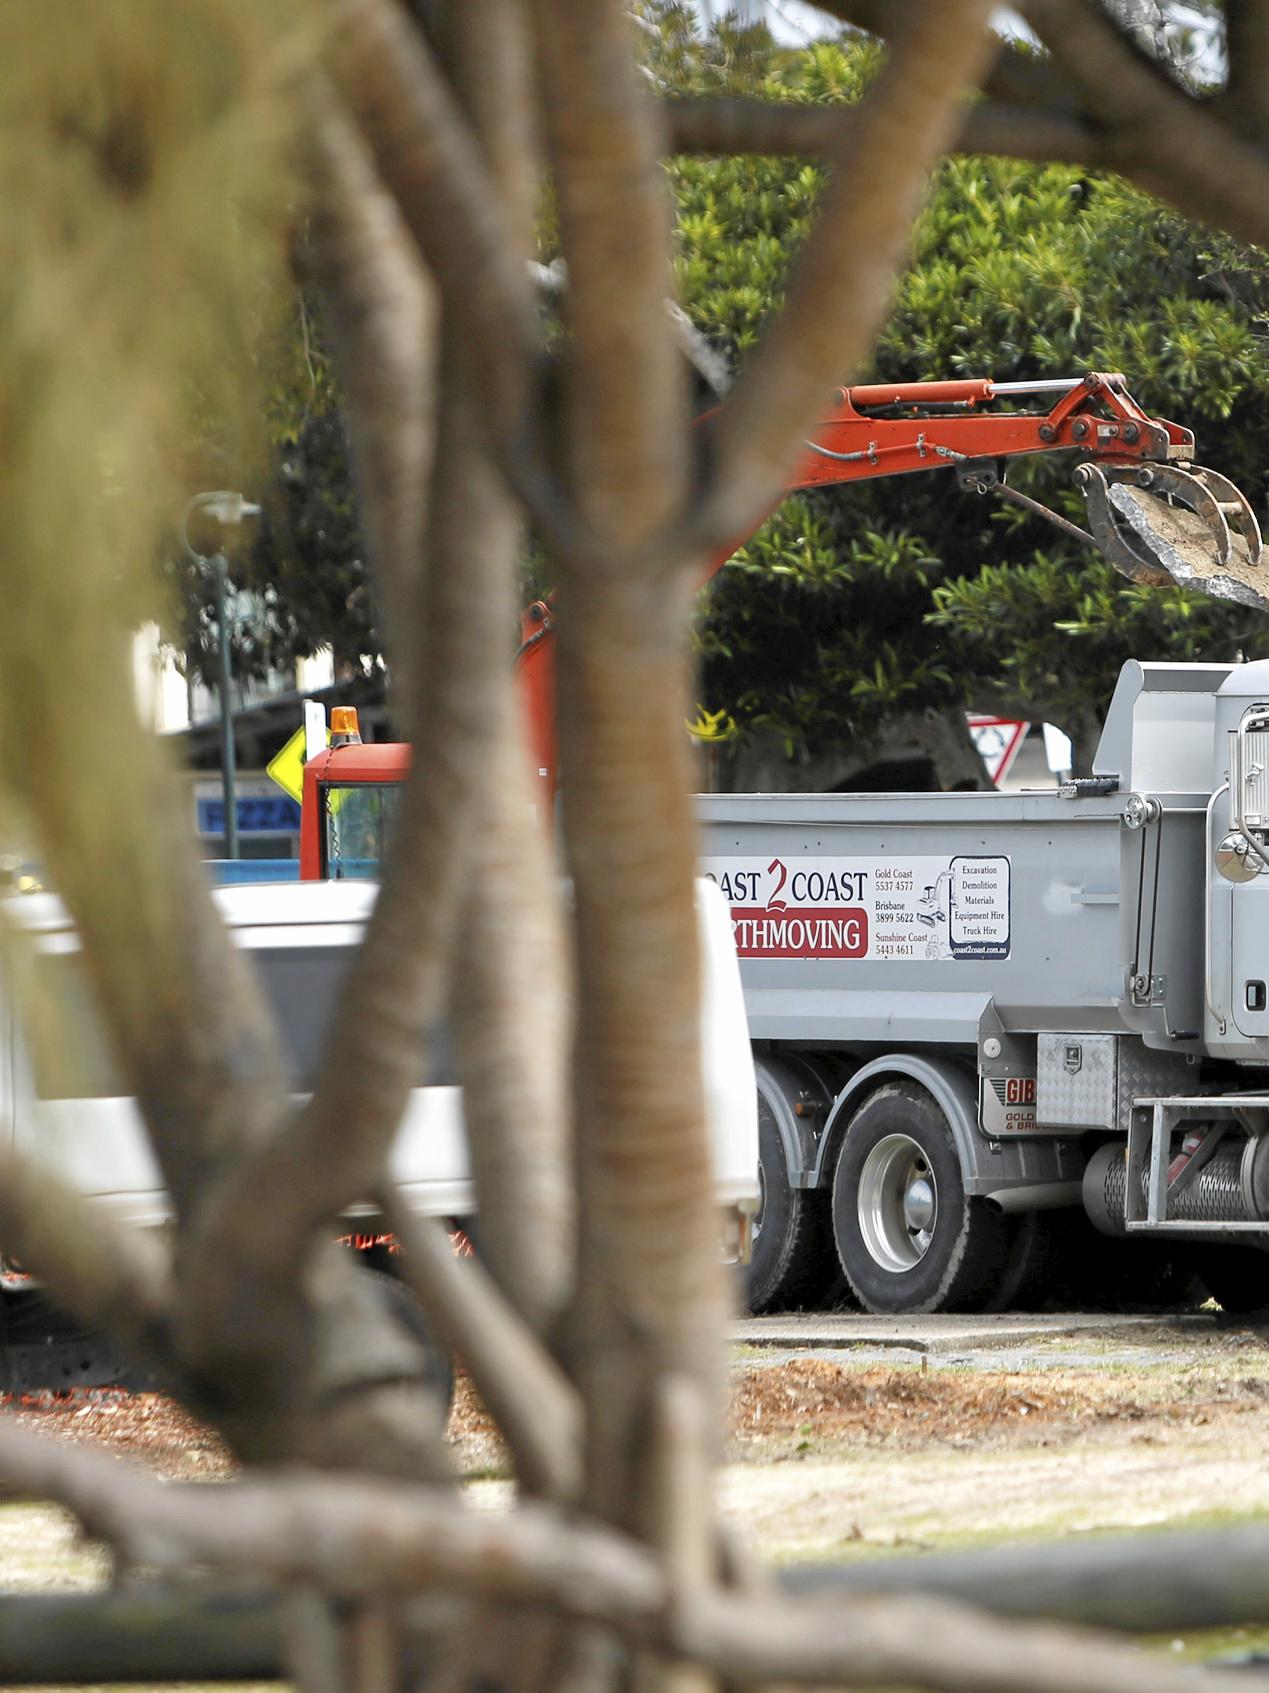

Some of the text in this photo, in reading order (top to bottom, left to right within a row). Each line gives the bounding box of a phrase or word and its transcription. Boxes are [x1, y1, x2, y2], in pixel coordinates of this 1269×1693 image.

[205, 800, 300, 830] PZZA
[875, 869, 913, 879] Gold Coast
[962, 866, 997, 874] Excavation
[767, 858, 787, 911] 2
[791, 872, 868, 901] COAST
[875, 882, 913, 891] 5537 4577
[962, 881, 997, 889] Demolition
[965, 896, 995, 904] Materials
[876, 901, 905, 910] Brisbane
[876, 913, 914, 923] 3899 5622
[955, 911, 1005, 921] Equipment Hire
[731, 919, 860, 949] RTHMOVING
[963, 926, 997, 935] Truck Hire
[876, 932, 928, 942] Sunshine Coast
[876, 945, 913, 954] 5443 4611
[953, 946, 1007, 954] coast2coast.com.au
[1006, 1113, 1034, 1121] GOLD
[1006, 1122, 1013, 1130] &
